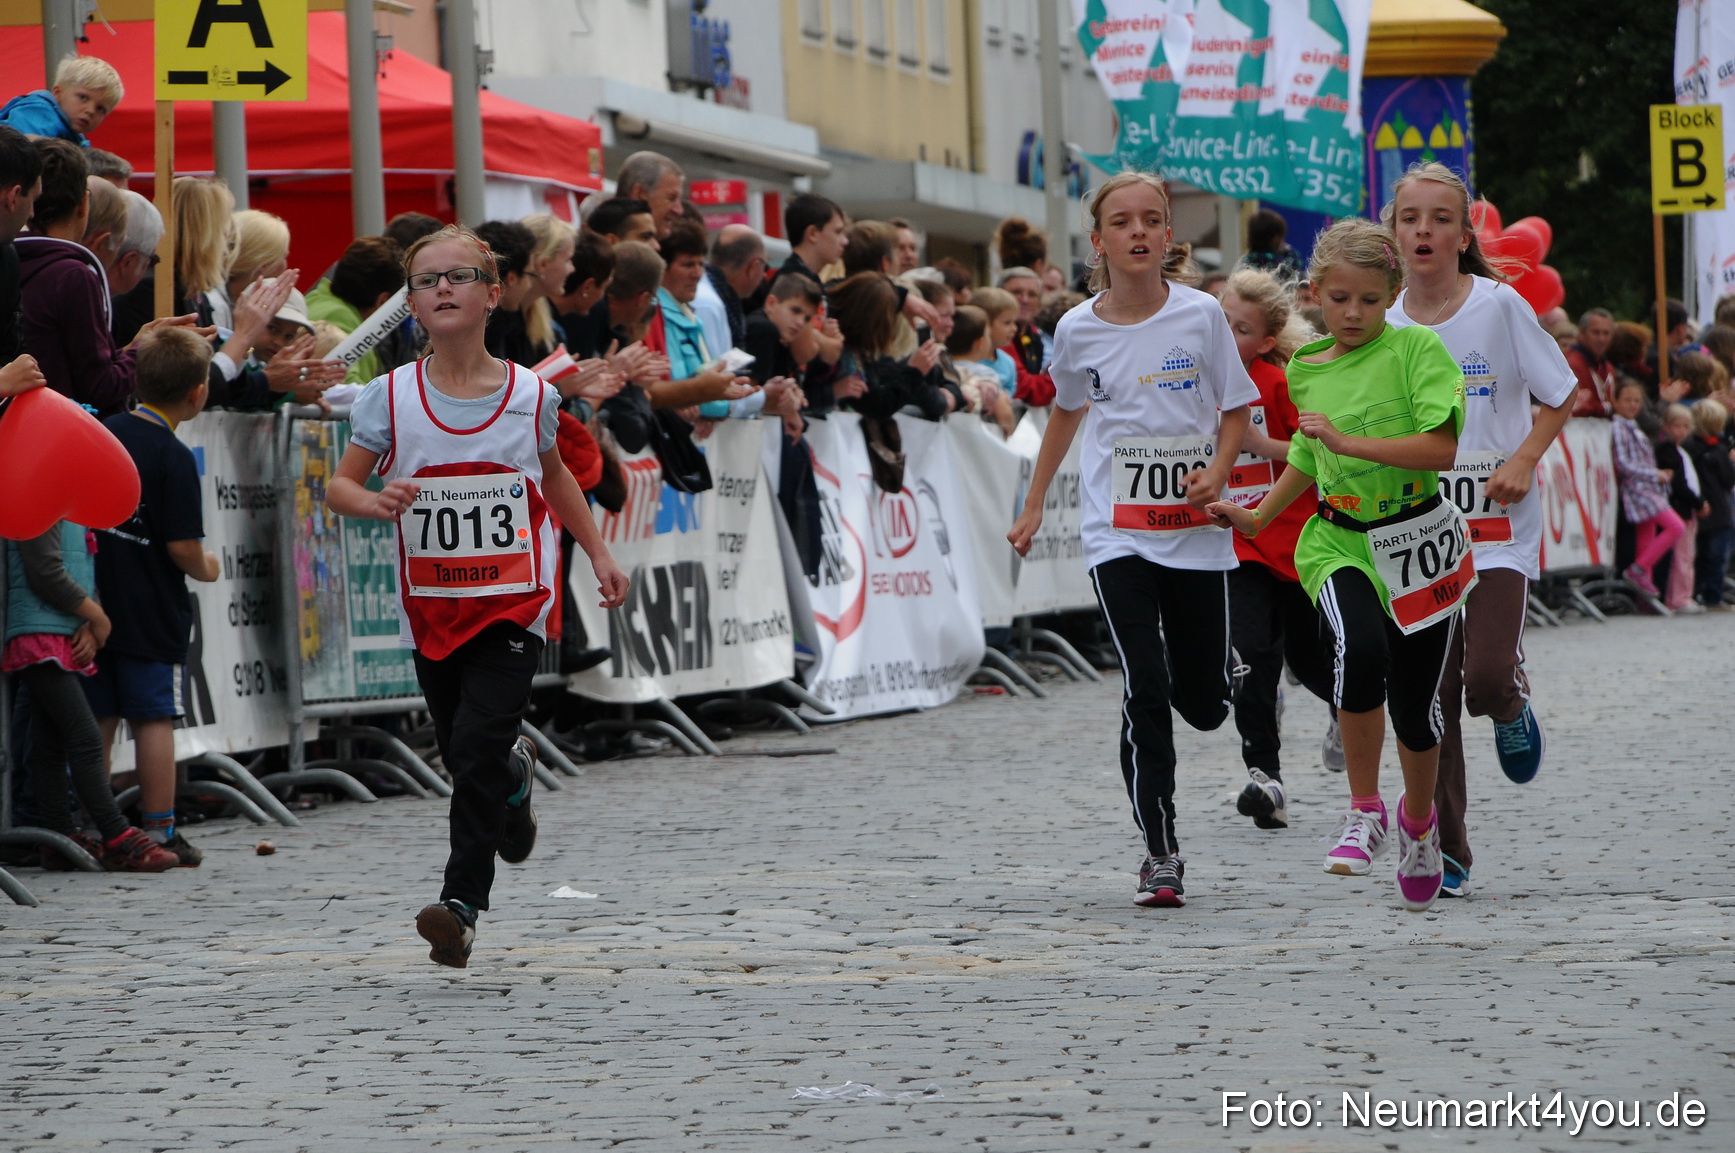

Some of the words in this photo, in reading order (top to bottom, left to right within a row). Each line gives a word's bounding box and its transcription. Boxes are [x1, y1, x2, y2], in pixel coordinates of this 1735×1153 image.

[187, 0, 274, 48] A
[1659, 108, 1715, 129] Block
[1671, 138, 1707, 188] B
[504, 409, 534, 417] BROOKS
[1114, 447, 1151, 458] PARTL
[1154, 446, 1202, 458] Neumarkt
[1125, 460, 1206, 499] 700
[441, 487, 505, 501] Neumarkt
[412, 503, 515, 551] 7013
[1147, 509, 1192, 526] Sarah
[1373, 531, 1417, 551] PARTL
[1388, 516, 1465, 589] 7020
[433, 563, 499, 582] Tamara
[1432, 580, 1460, 606] Mia
